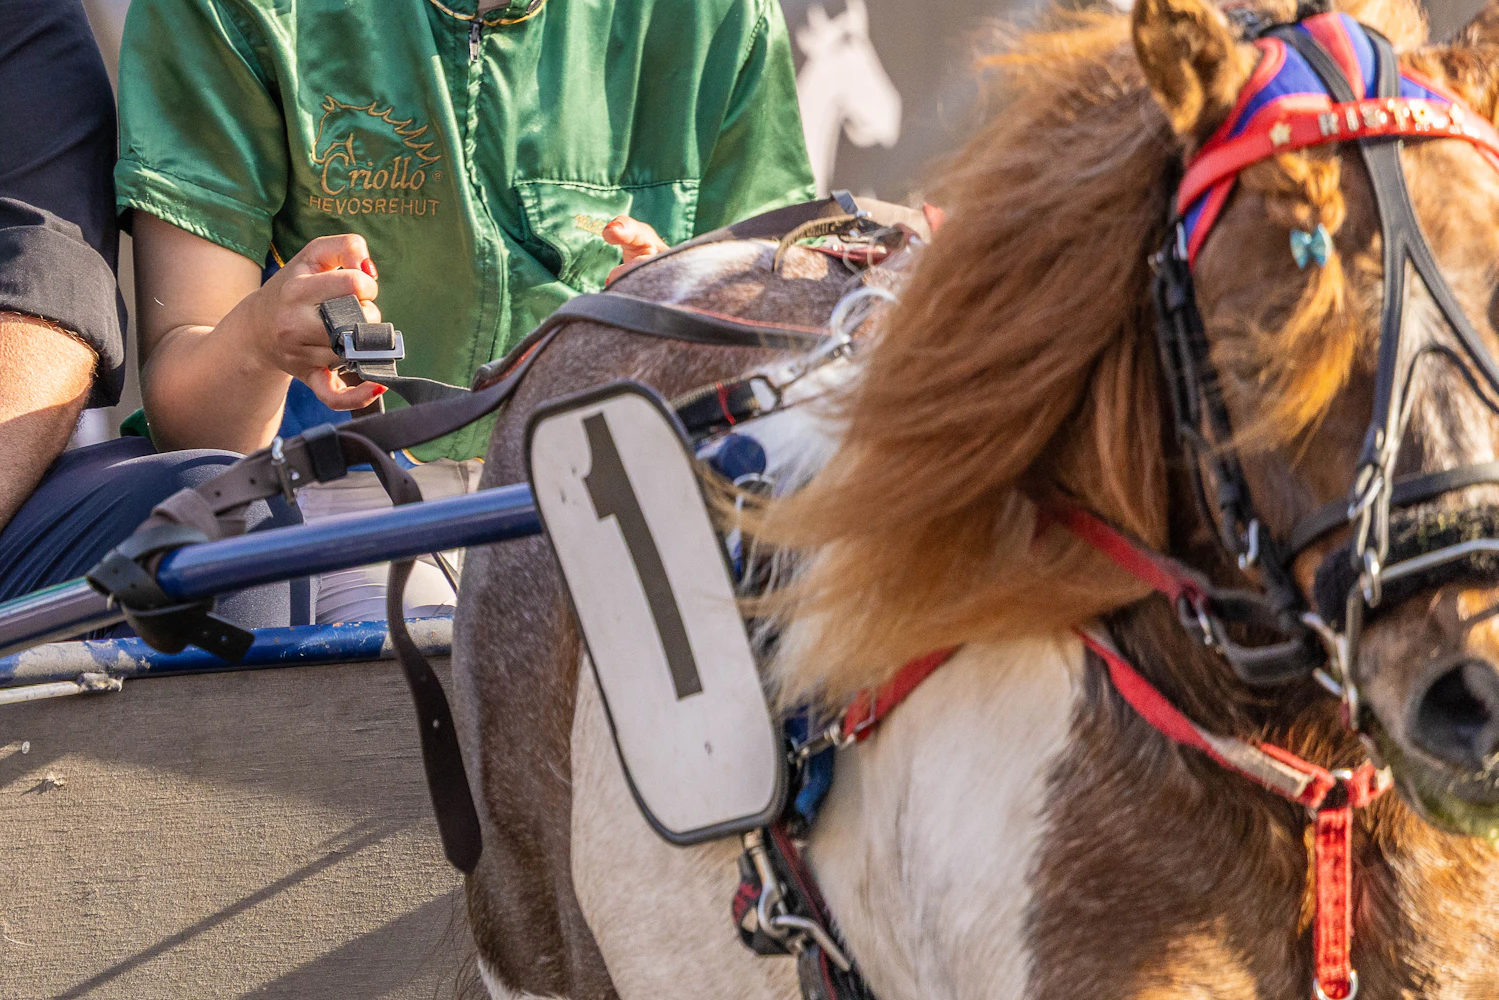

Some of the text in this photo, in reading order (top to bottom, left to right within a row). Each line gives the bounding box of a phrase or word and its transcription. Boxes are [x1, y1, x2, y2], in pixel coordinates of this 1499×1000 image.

[320, 152, 427, 196] Criollo
[309, 194, 441, 217] HEVOSREHUT
[581, 412, 703, 701] 1
